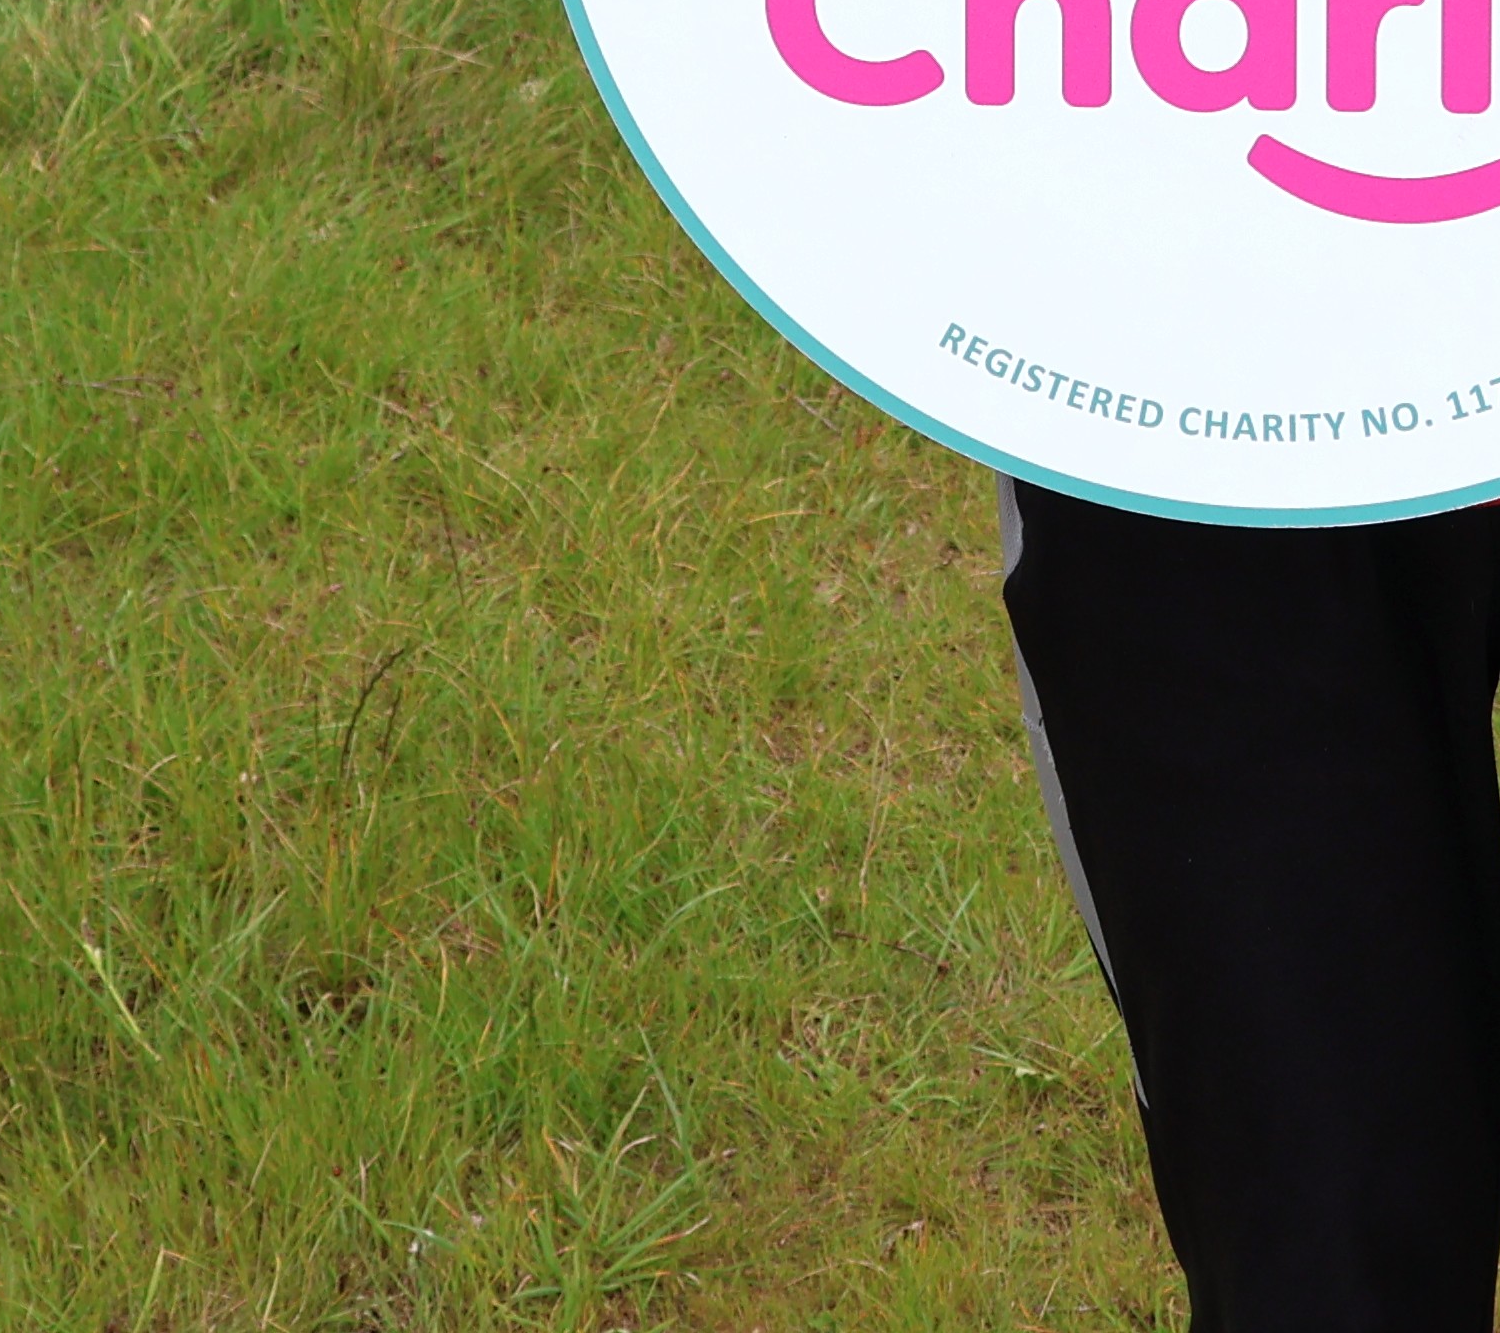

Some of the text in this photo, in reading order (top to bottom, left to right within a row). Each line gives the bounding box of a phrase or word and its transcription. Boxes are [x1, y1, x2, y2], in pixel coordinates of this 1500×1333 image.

[939, 322, 1164, 429] REGISTERED
[1179, 406, 1345, 442] CHARITY
[1361, 401, 1434, 438] NO.
